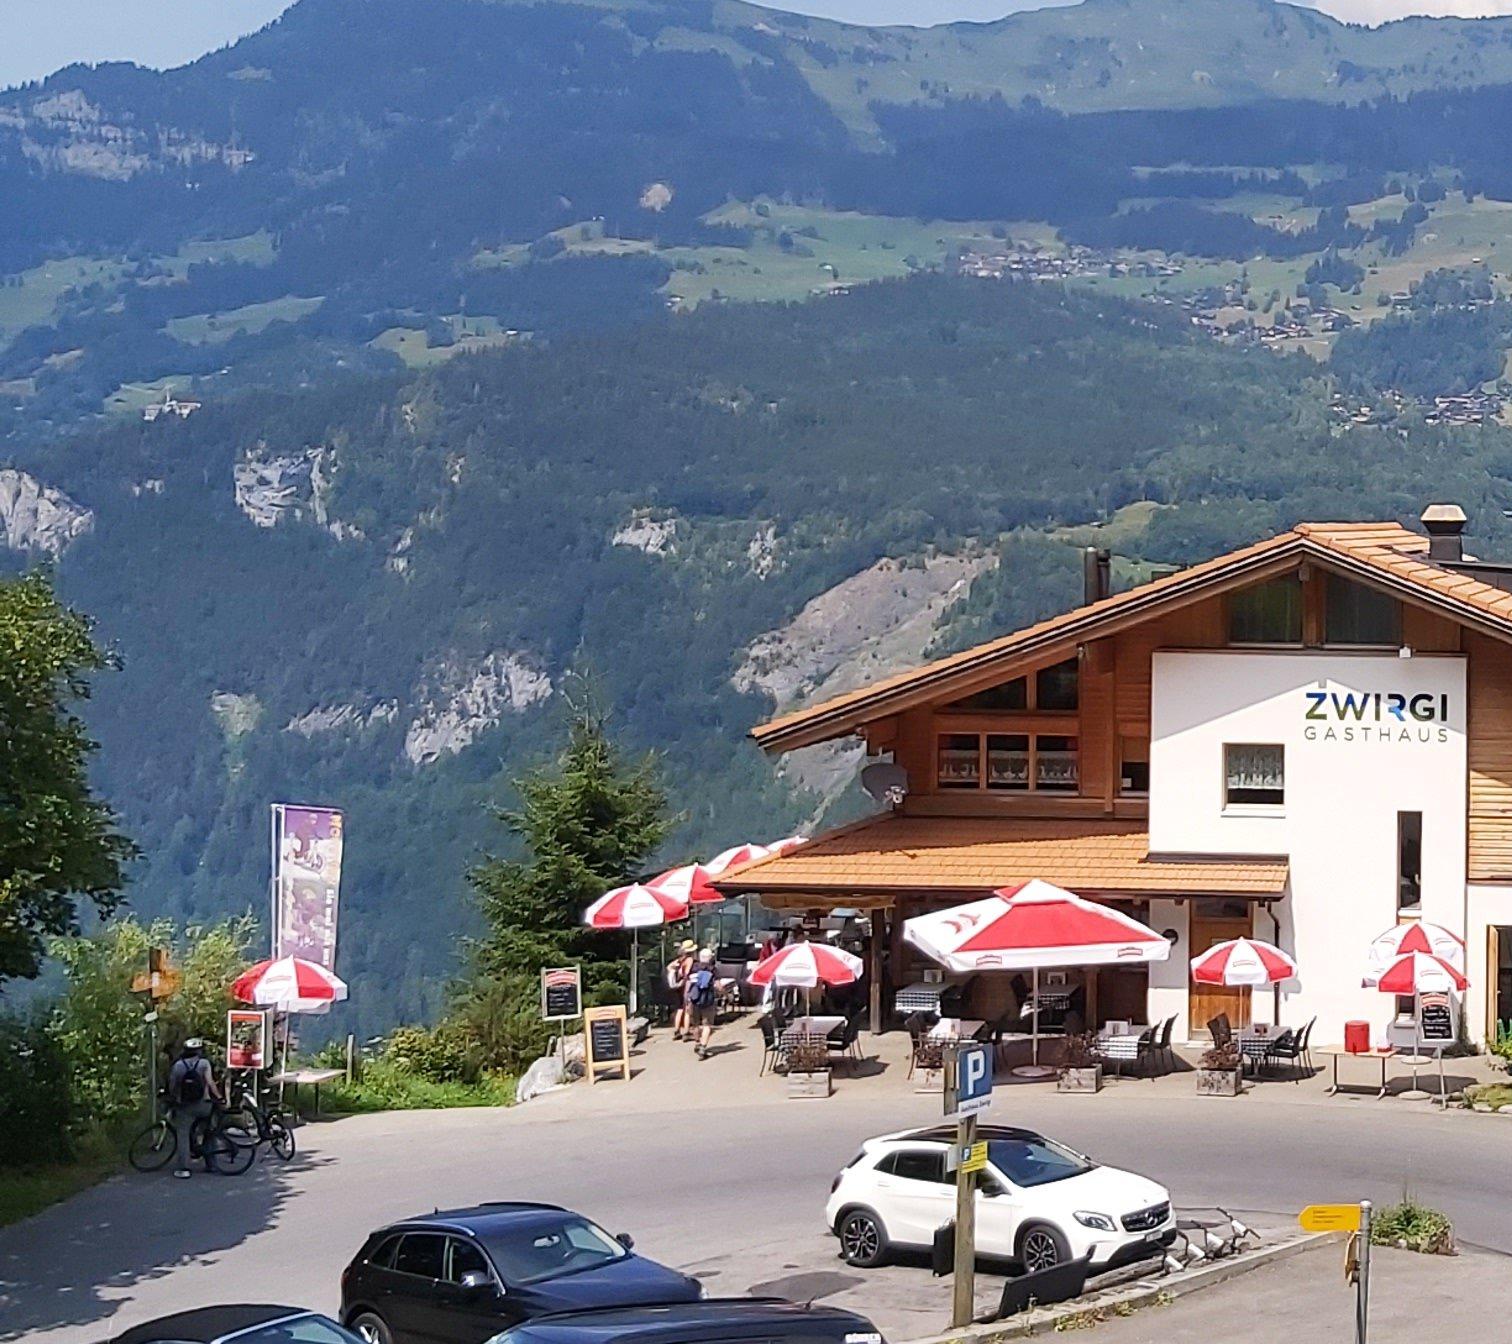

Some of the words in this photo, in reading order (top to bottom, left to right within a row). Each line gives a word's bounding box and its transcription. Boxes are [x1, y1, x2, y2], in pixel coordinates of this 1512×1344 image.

[1305, 692, 1448, 722] ZWIRGI
[1304, 726, 1448, 743] GASTHAUS
[967, 1050, 985, 1095] P
